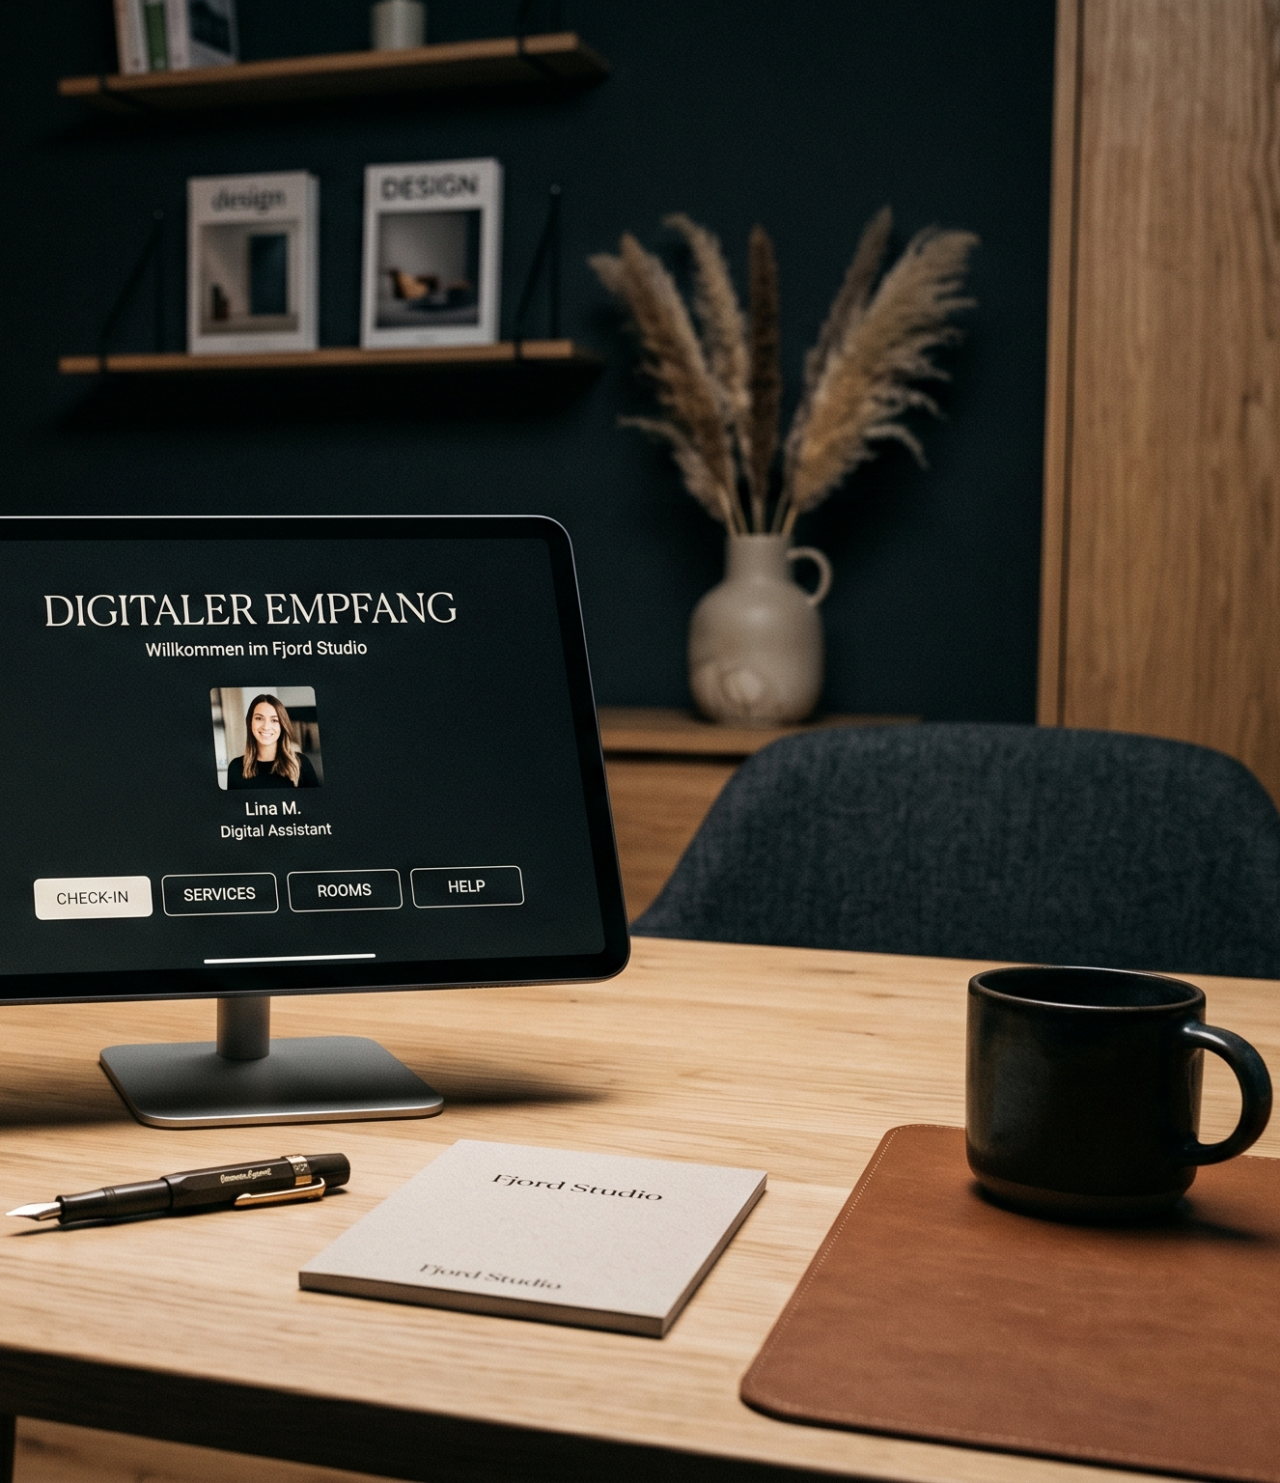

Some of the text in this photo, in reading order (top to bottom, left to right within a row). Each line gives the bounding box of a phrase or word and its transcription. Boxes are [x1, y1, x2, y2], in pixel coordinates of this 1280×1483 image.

[382, 174, 478, 200] DESIGN
[43, 591, 458, 627] DIGITALER EMPFANG
[145, 639, 368, 660] Willkommen im Fjord Studio
[245, 800, 302, 816] Lina M.
[220, 821, 333, 841] Digital Assistant
[183, 886, 256, 902] SERVICES
[317, 882, 372, 898] ROOMS
[448, 879, 486, 894] HELP
[56, 890, 130, 906] CHECK-IN
[492, 1173, 663, 1201] Fjord Studio
[419, 1263, 562, 1290] Fjord Studio
